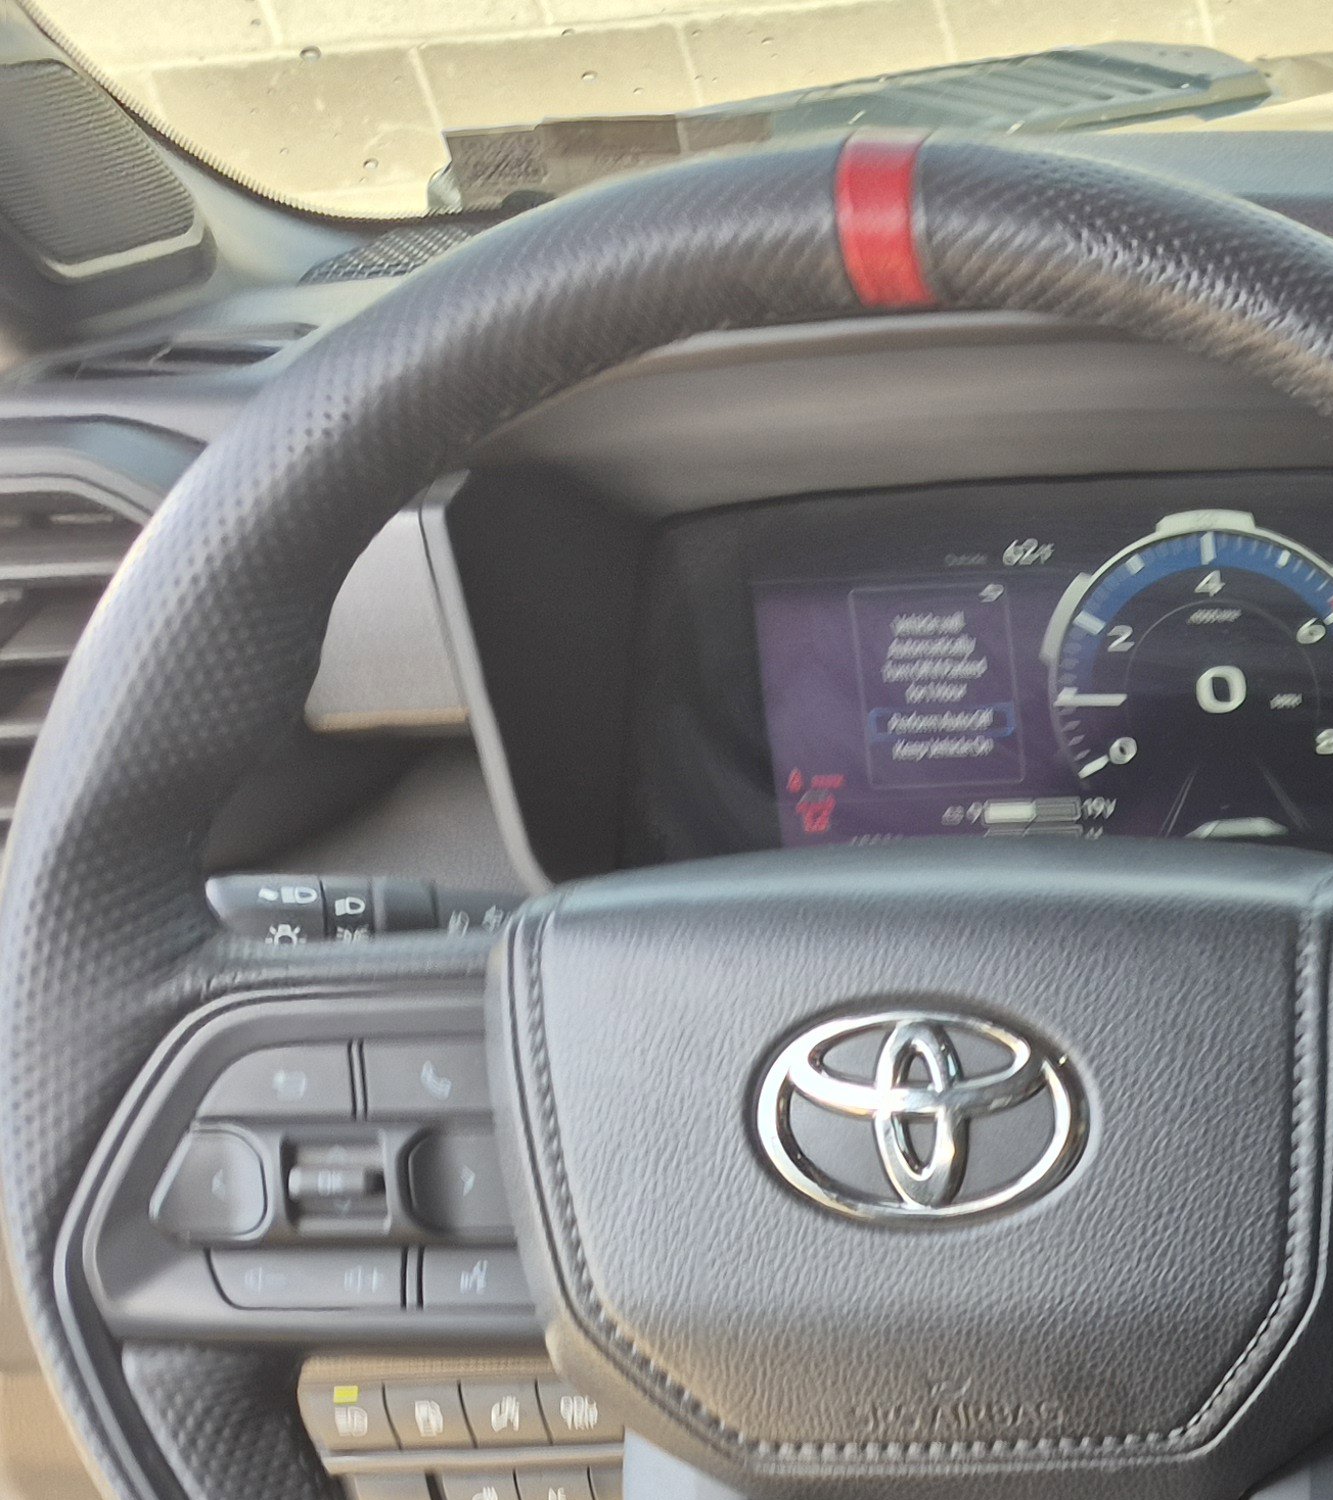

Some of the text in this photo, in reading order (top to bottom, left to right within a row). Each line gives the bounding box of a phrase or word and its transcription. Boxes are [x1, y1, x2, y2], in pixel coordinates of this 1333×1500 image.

[1194, 569, 1226, 597] 4
[1107, 624, 1135, 652] 2
[1296, 617, 1326, 645] 6
[1195, 665, 1247, 714] 0
[1109, 736, 1138, 765] 0
